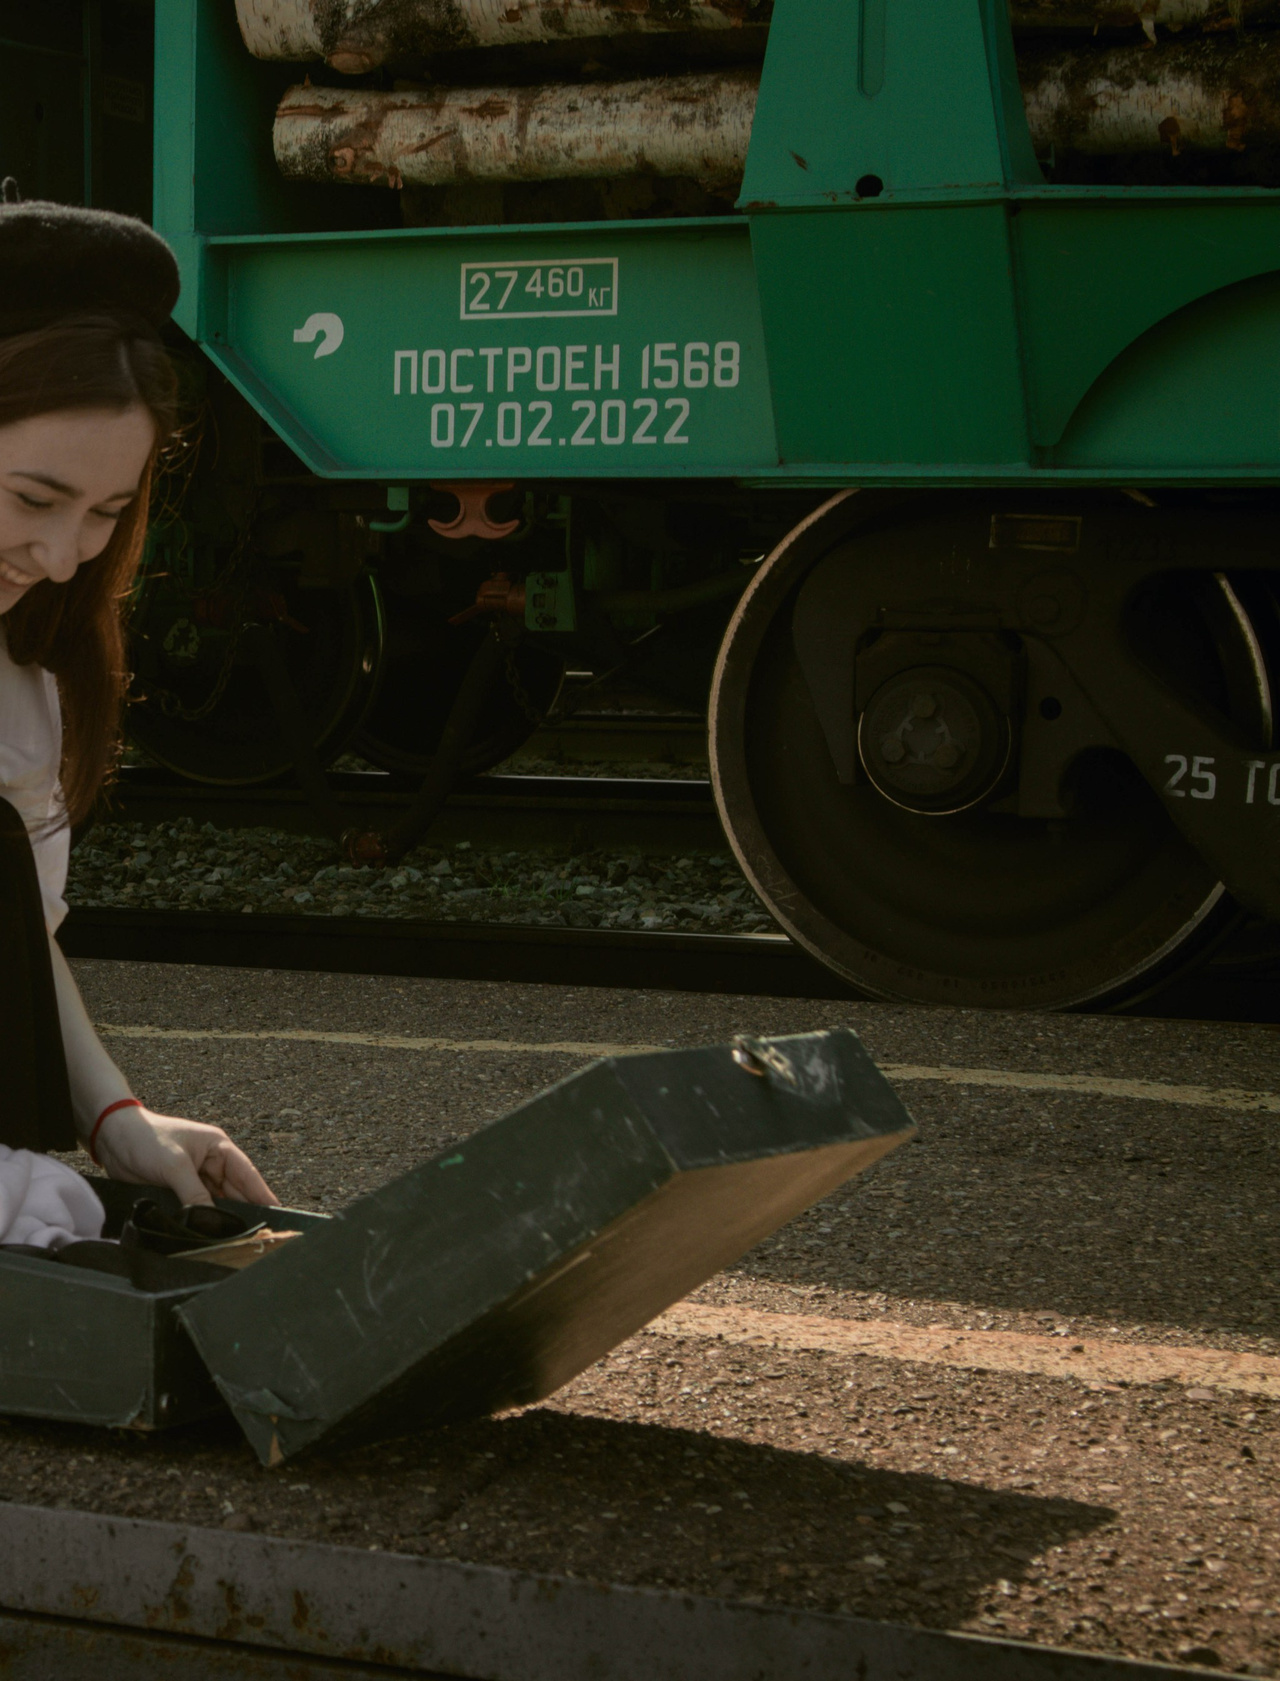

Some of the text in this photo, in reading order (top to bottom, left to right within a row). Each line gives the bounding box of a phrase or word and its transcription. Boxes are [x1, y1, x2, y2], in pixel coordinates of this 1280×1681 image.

[393, 341, 740, 395] ПОСТРОЕН 1568
[430, 398, 690, 448] 07.02.2022
[1163, 754, 1217, 800] 25
